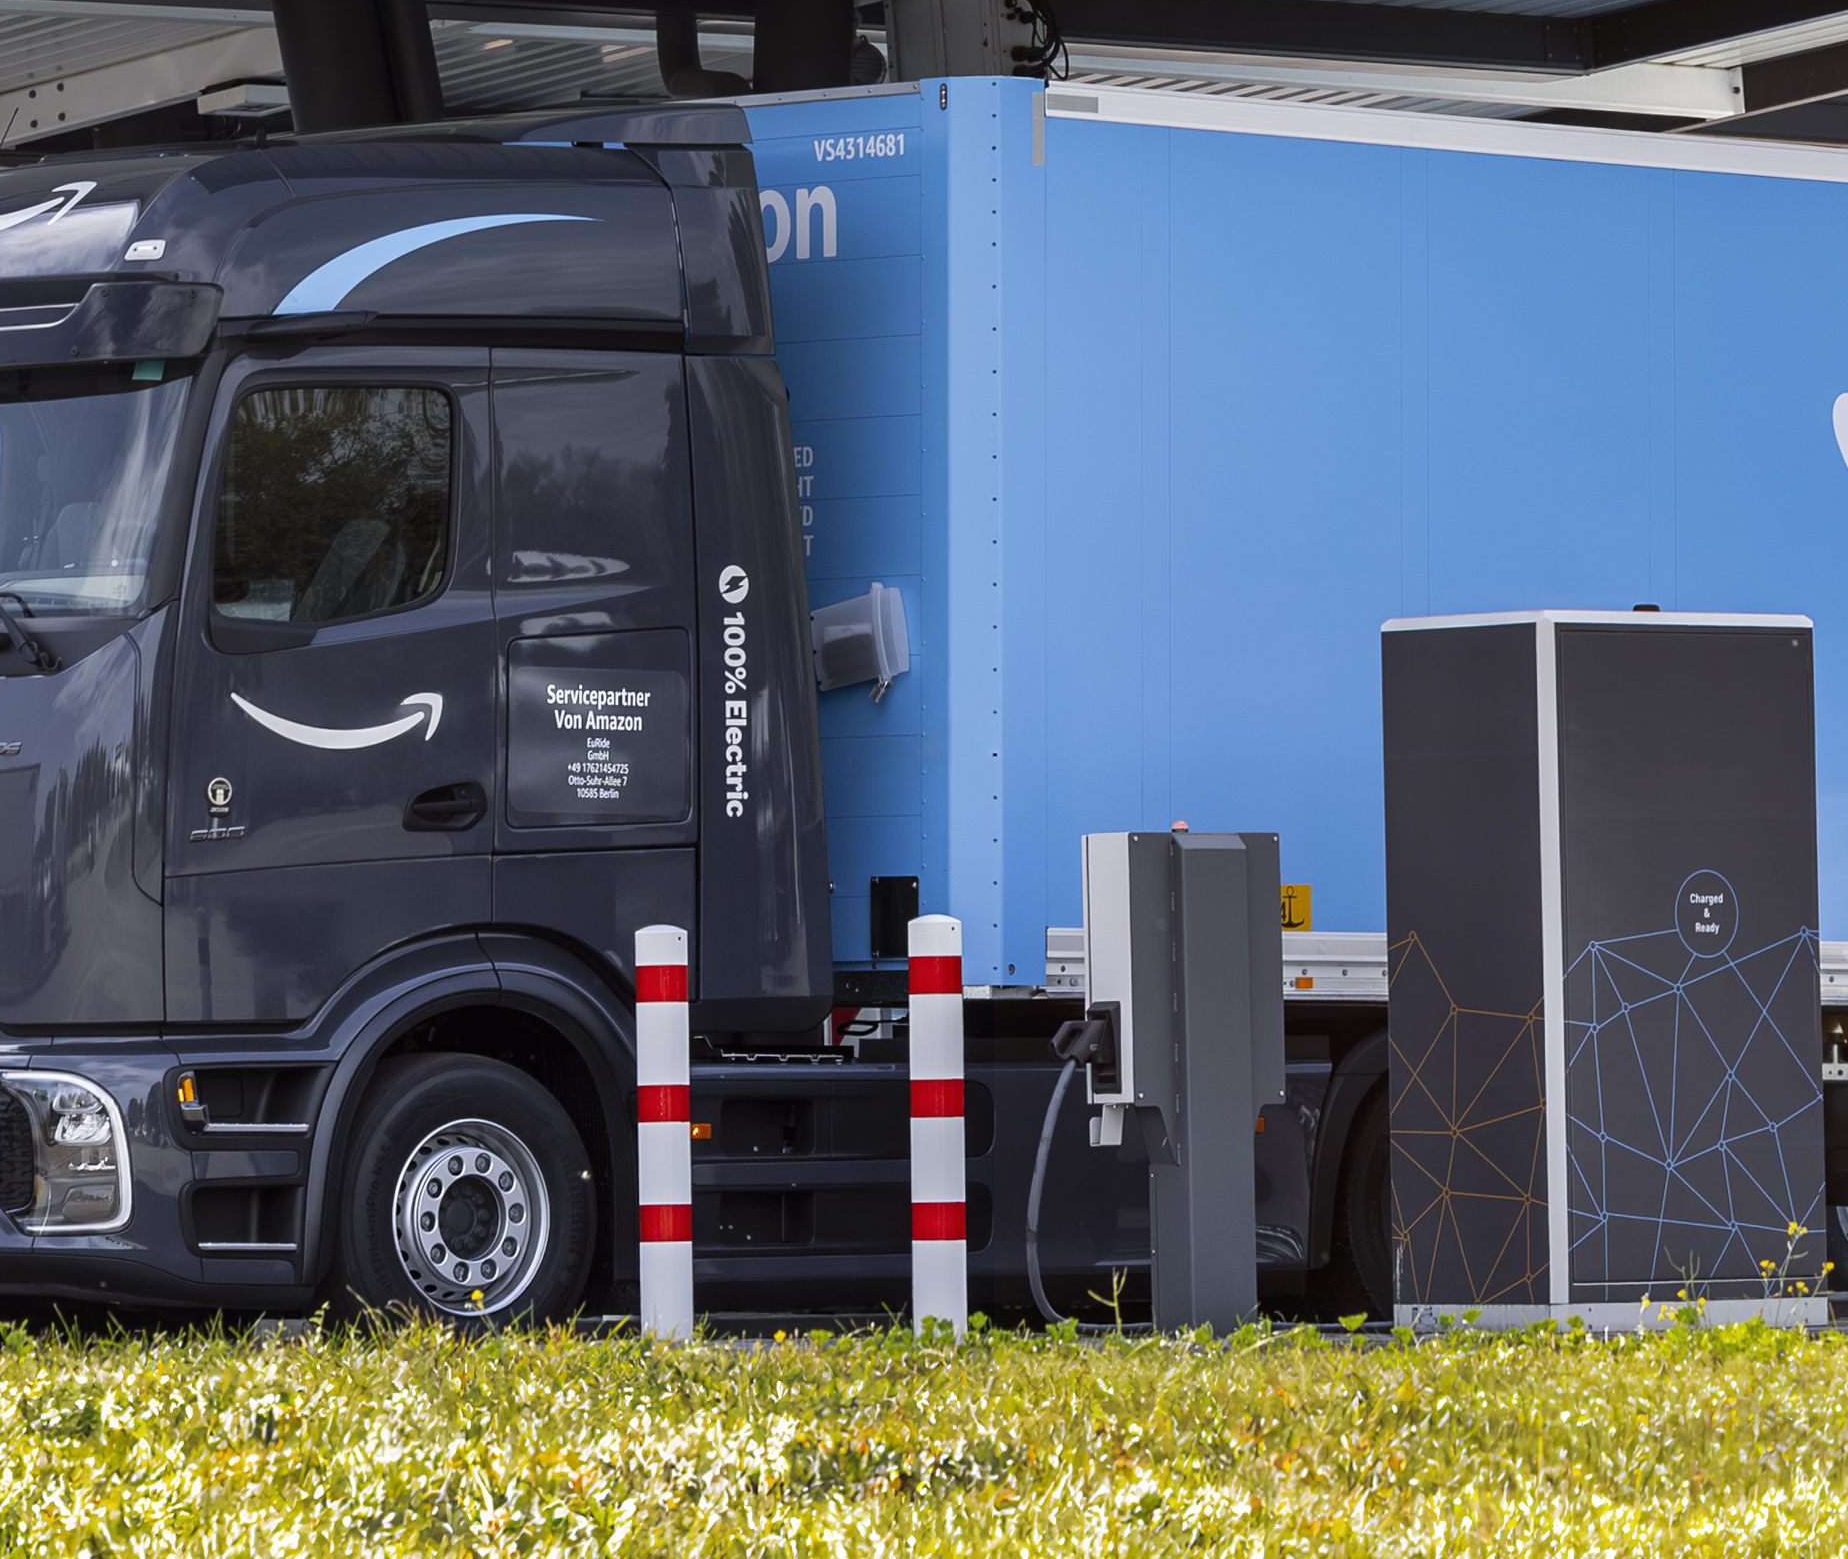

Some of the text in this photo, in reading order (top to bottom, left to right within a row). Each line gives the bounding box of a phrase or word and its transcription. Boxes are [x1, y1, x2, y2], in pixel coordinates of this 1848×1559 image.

[813, 133, 905, 162] VS4314681
[546, 684, 651, 710] Servicepartner
[554, 709, 643, 731] Von Amazon
[723, 611, 749, 818] 100% Electric
[587, 750, 610, 761] GmbH
[567, 762, 581, 773] +49
[567, 775, 622, 787] Otto-Suhr-Allee
[599, 788, 620, 799] Berlin
[1689, 893, 1724, 906] Charged
[1703, 907, 1711, 918] &
[1695, 922, 1720, 935] Ready
